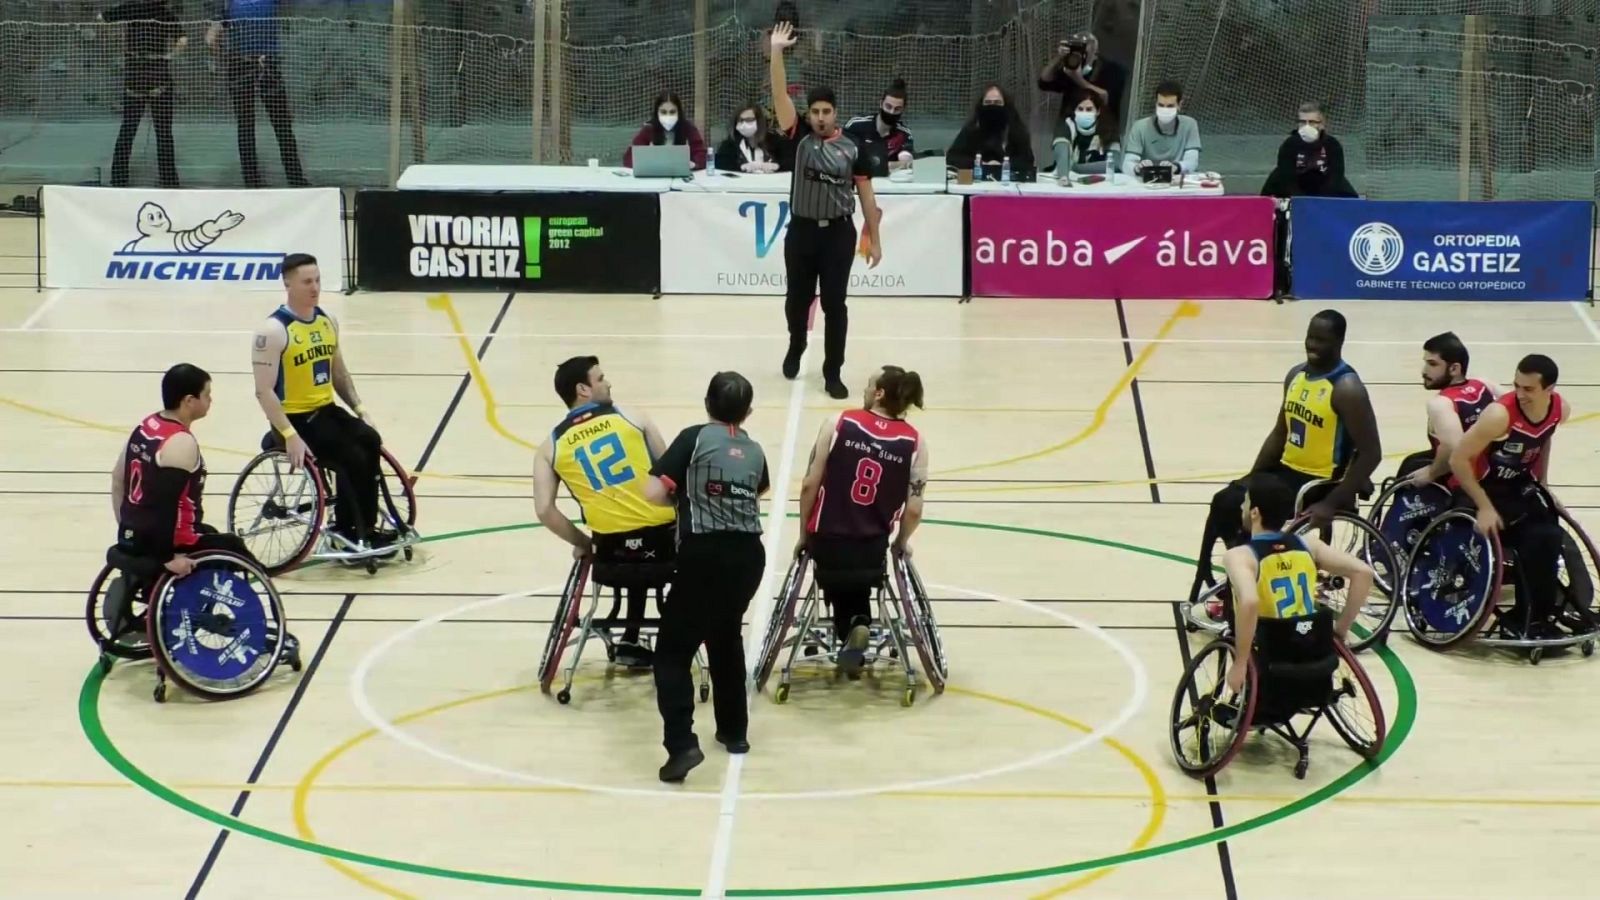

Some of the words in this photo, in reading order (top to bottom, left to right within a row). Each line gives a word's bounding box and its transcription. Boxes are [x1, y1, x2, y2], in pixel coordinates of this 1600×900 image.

[408, 215, 520, 247] VITORIA
[548, 216, 588, 226] european
[548, 228, 573, 238] green
[574, 227, 604, 237] capital
[549, 239, 570, 249] 2012
[975, 238, 1092, 267] araba
[1156, 229, 1268, 267] álava
[1433, 234, 1521, 249] ORTOPEDIA
[106, 259, 284, 281] MICHELIN
[410, 246, 521, 279] GASTEIZ
[1413, 252, 1521, 274] GASTEIZ
[1356, 279, 1407, 290] GABINETE
[1410, 279, 1456, 290] TÉCNICO
[1458, 279, 1526, 291] ORTOPÉDICO
[309, 331, 323, 343] 23
[566, 419, 612, 446] LATHAM
[574, 432, 636, 492] 12
[129, 459, 145, 505] 0
[850, 457, 883, 506] 8
[1270, 572, 1313, 618] 21
